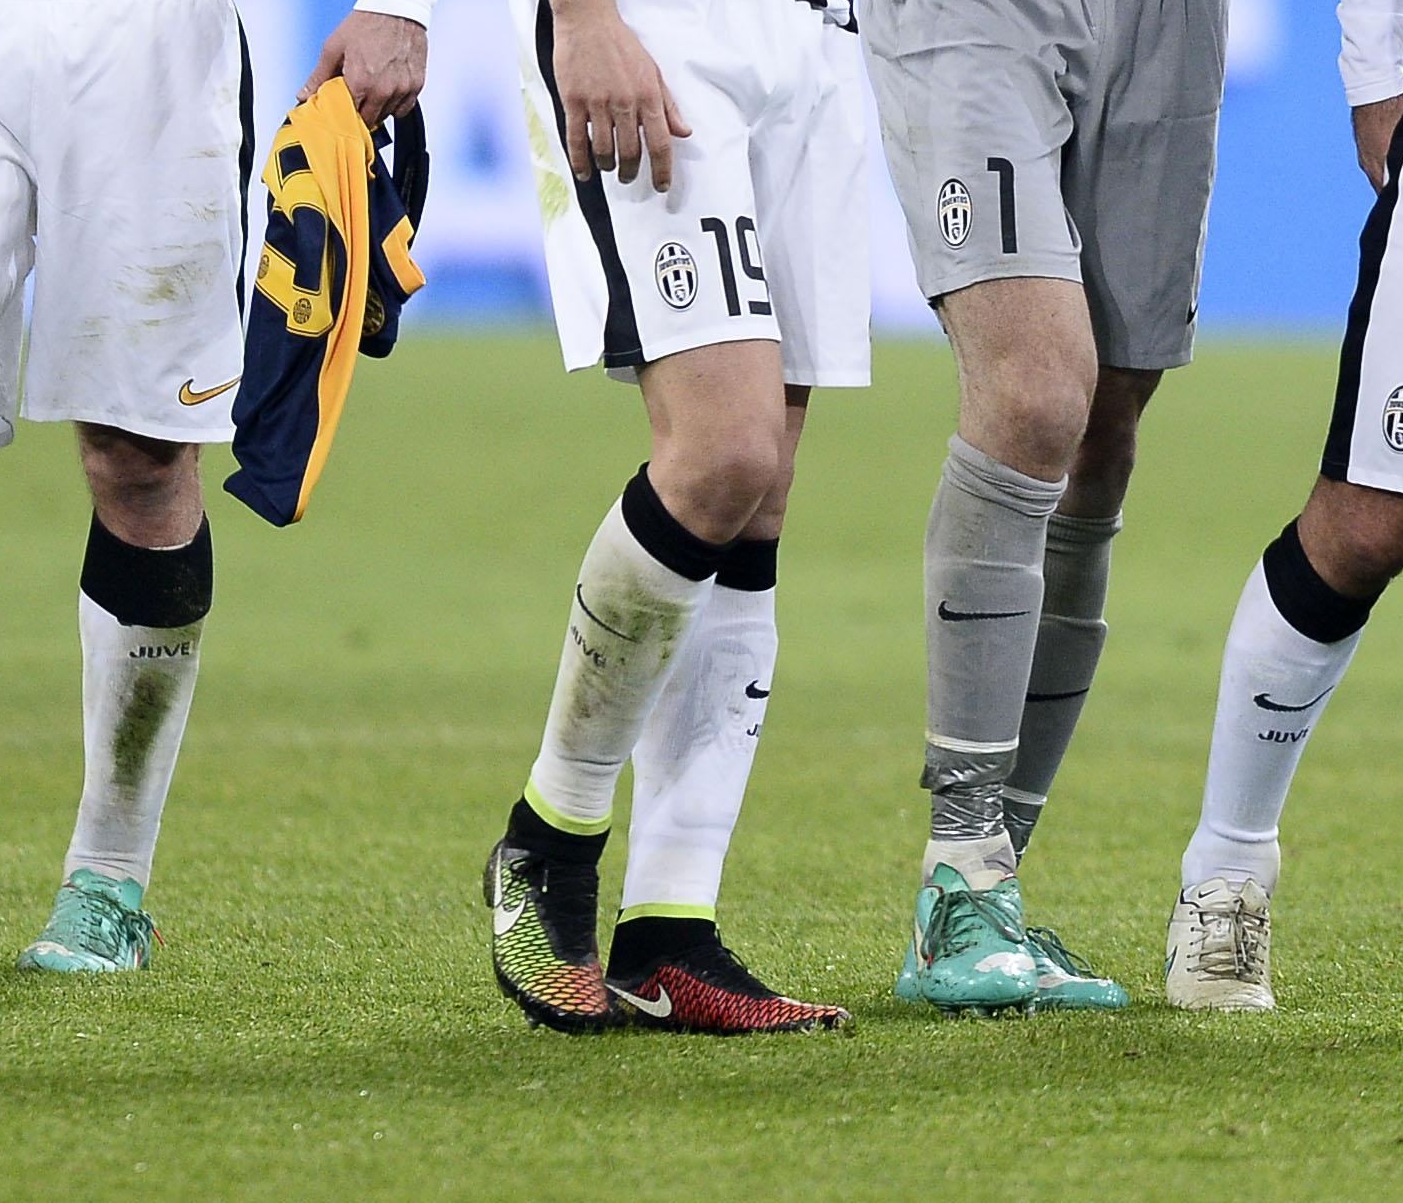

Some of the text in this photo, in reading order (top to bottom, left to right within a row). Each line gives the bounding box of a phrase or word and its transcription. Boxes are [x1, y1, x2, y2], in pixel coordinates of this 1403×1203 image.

[986, 156, 1018, 254] 1
[699, 215, 773, 317] 19
[128, 640, 191, 659] JUVE
